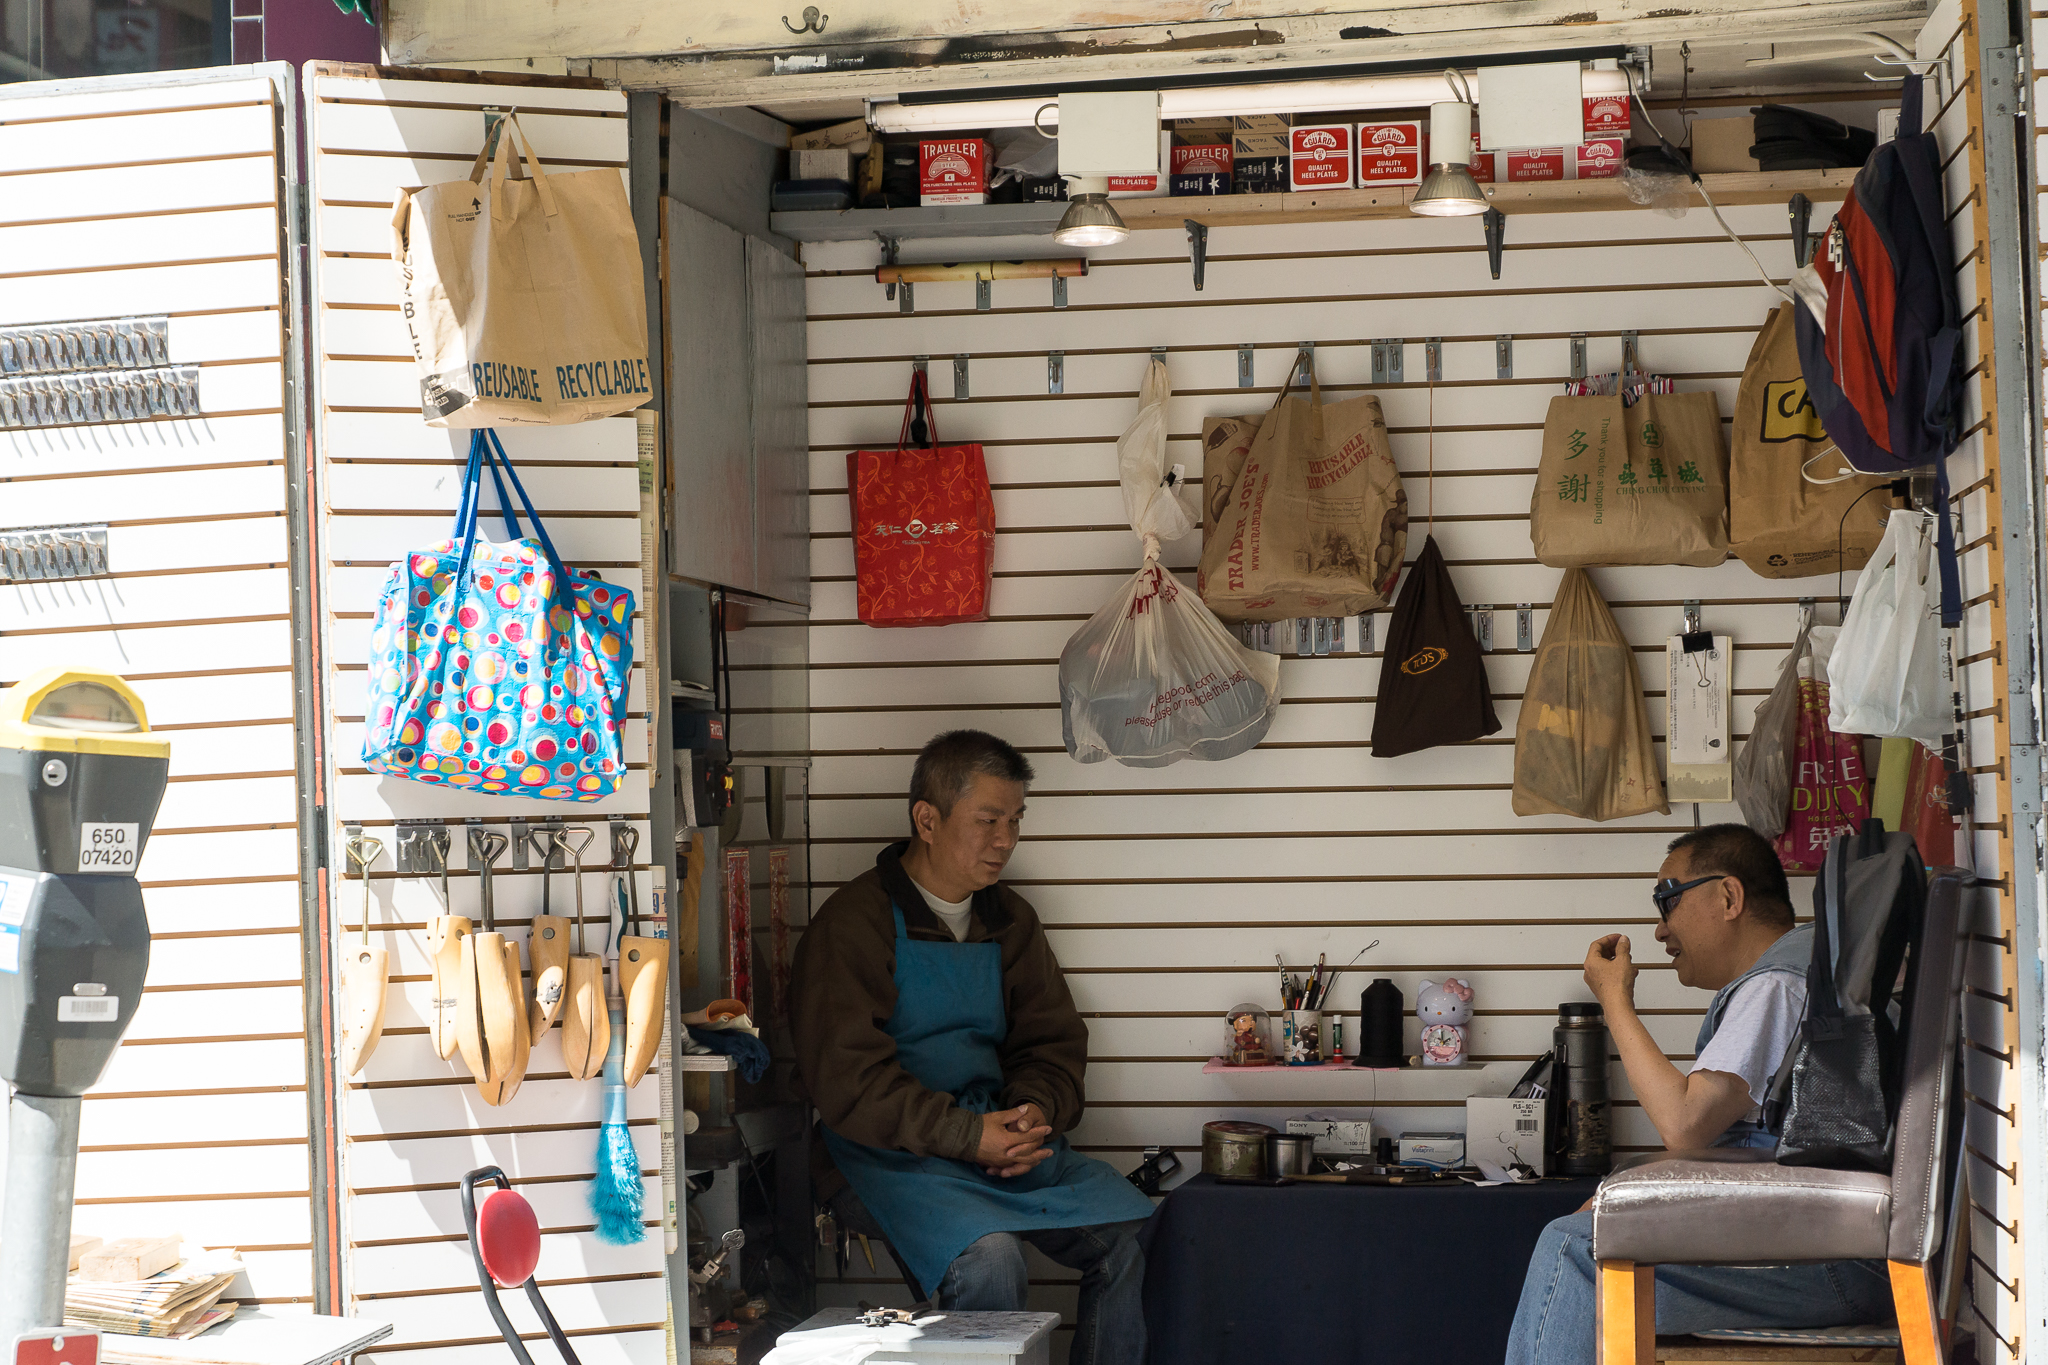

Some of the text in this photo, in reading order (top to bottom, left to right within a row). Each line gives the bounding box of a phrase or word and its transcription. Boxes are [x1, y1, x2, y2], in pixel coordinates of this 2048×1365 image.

[1308, 136, 1332, 146] GUARD
[1377, 132, 1402, 142] GUARD
[923, 142, 977, 160] TRAVELER
[1174, 147, 1229, 164] TRAVELER
[1376, 159, 1402, 167] QUALITY
[1316, 170, 1338, 178] PLATES
[472, 361, 542, 403] REUSABLE
[556, 359, 649, 400] RECYCLABLE
[1307, 433, 1366, 475] REUSABLE
[1559, 428, 1591, 504] 多謝
[1594, 417, 1611, 525] Thank you for shopping
[875, 525, 903, 536] 天仁
[1228, 463, 1260, 591] TRADER JOE'S
[1173, 699, 1182, 711] or
[1211, 681, 1230, 697] this
[1792, 782, 1865, 812] DUTY
[92, 828, 125, 844] 650
[82, 850, 133, 865] 07420
